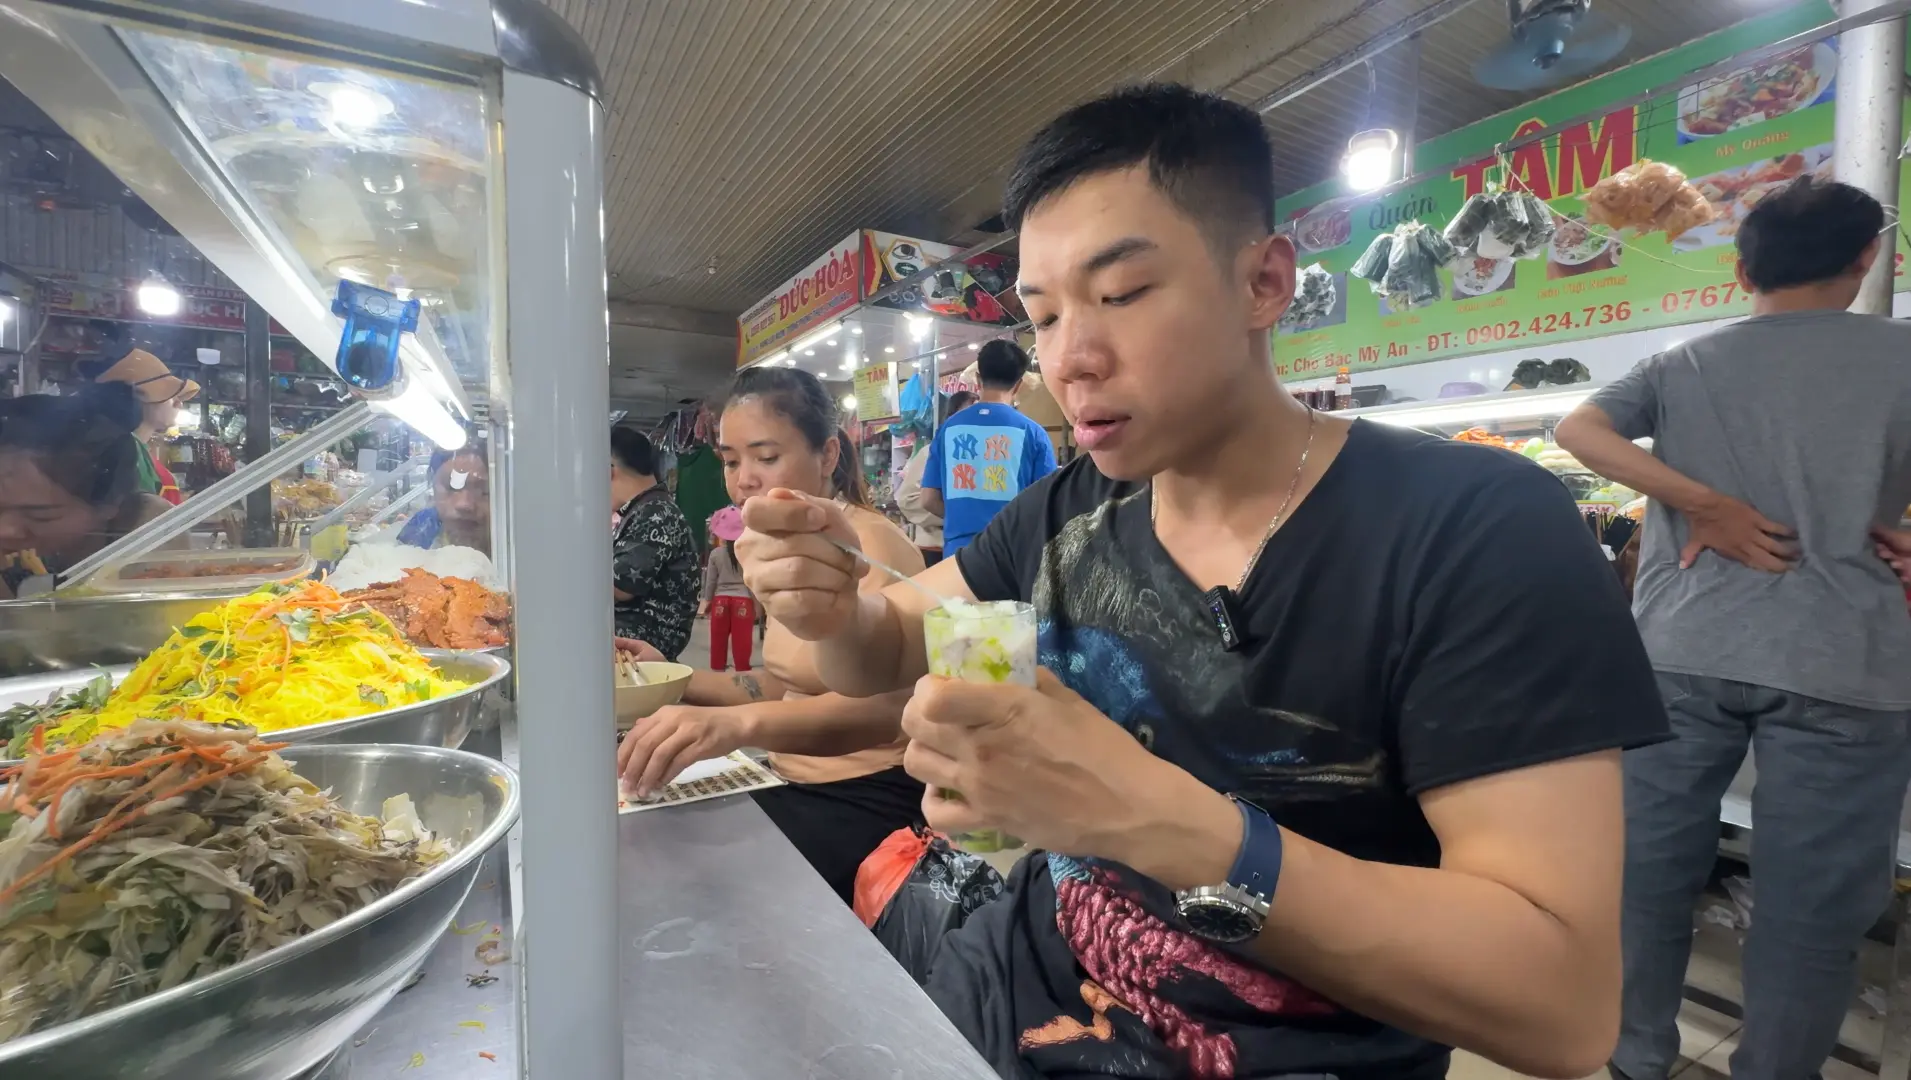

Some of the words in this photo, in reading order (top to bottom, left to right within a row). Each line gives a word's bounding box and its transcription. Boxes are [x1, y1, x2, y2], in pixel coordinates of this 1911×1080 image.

[1450, 105, 1640, 202] TÂM
[779, 277, 811, 321] ĐỨC
[1358, 344, 1381, 364] Mỹ
[1387, 341, 1409, 359] An
[1427, 331, 1459, 352] ĐT:
[1466, 300, 1632, 346] 0902.424.736
